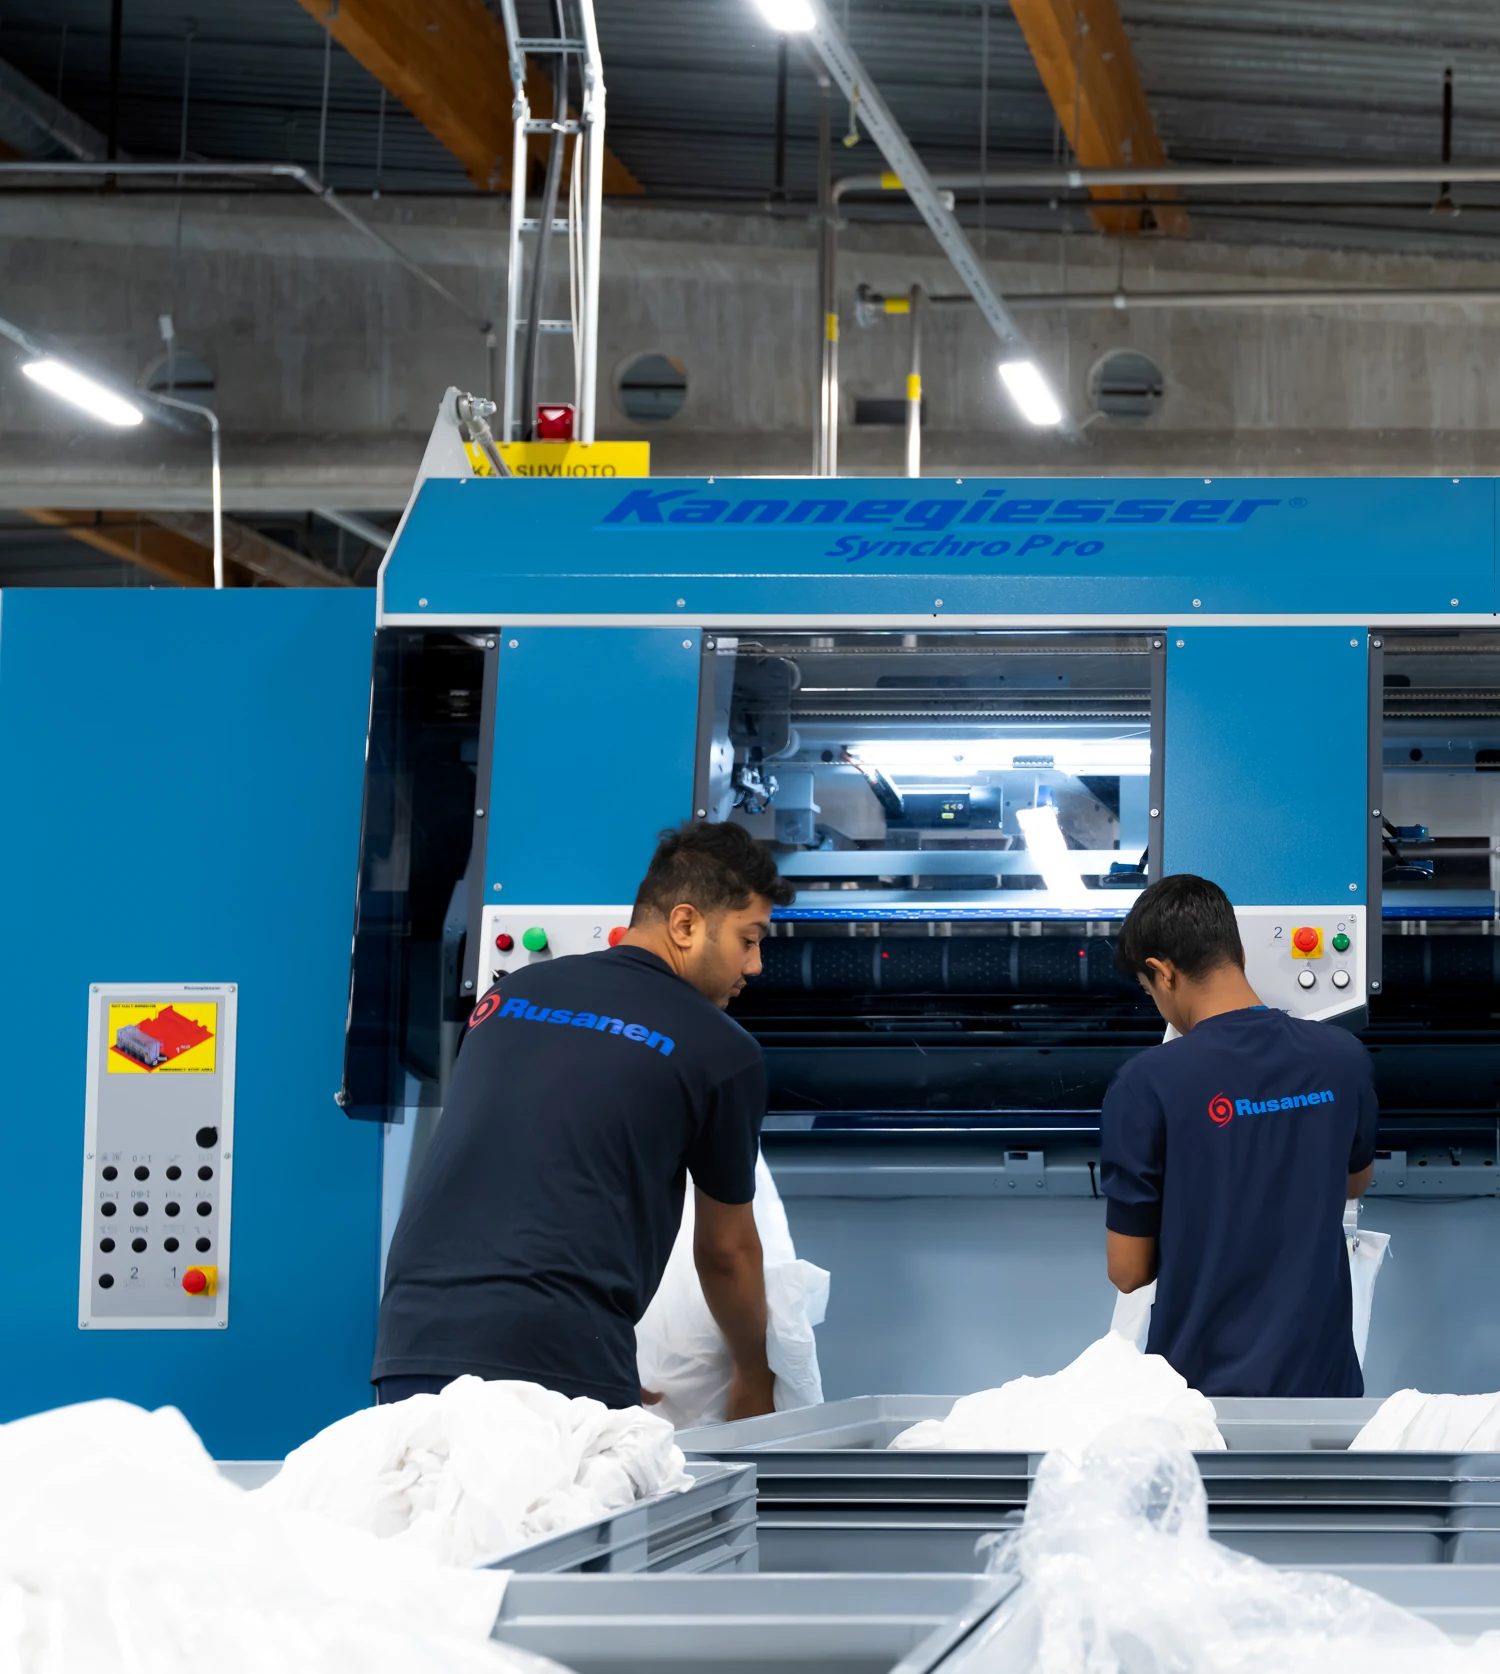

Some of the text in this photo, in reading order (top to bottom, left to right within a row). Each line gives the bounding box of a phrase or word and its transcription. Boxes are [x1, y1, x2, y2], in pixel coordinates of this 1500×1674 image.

[601, 489, 1283, 532] Kannegiesser
[824, 534, 1105, 563] Synchro Pro
[593, 926, 602, 939] 2
[1274, 926, 1283, 939] 2
[498, 997, 676, 1057] Rusanen
[1235, 1089, 1335, 1117] Rusanen
[130, 1266, 139, 1280] 2
[172, 1266, 177, 1280] 1
